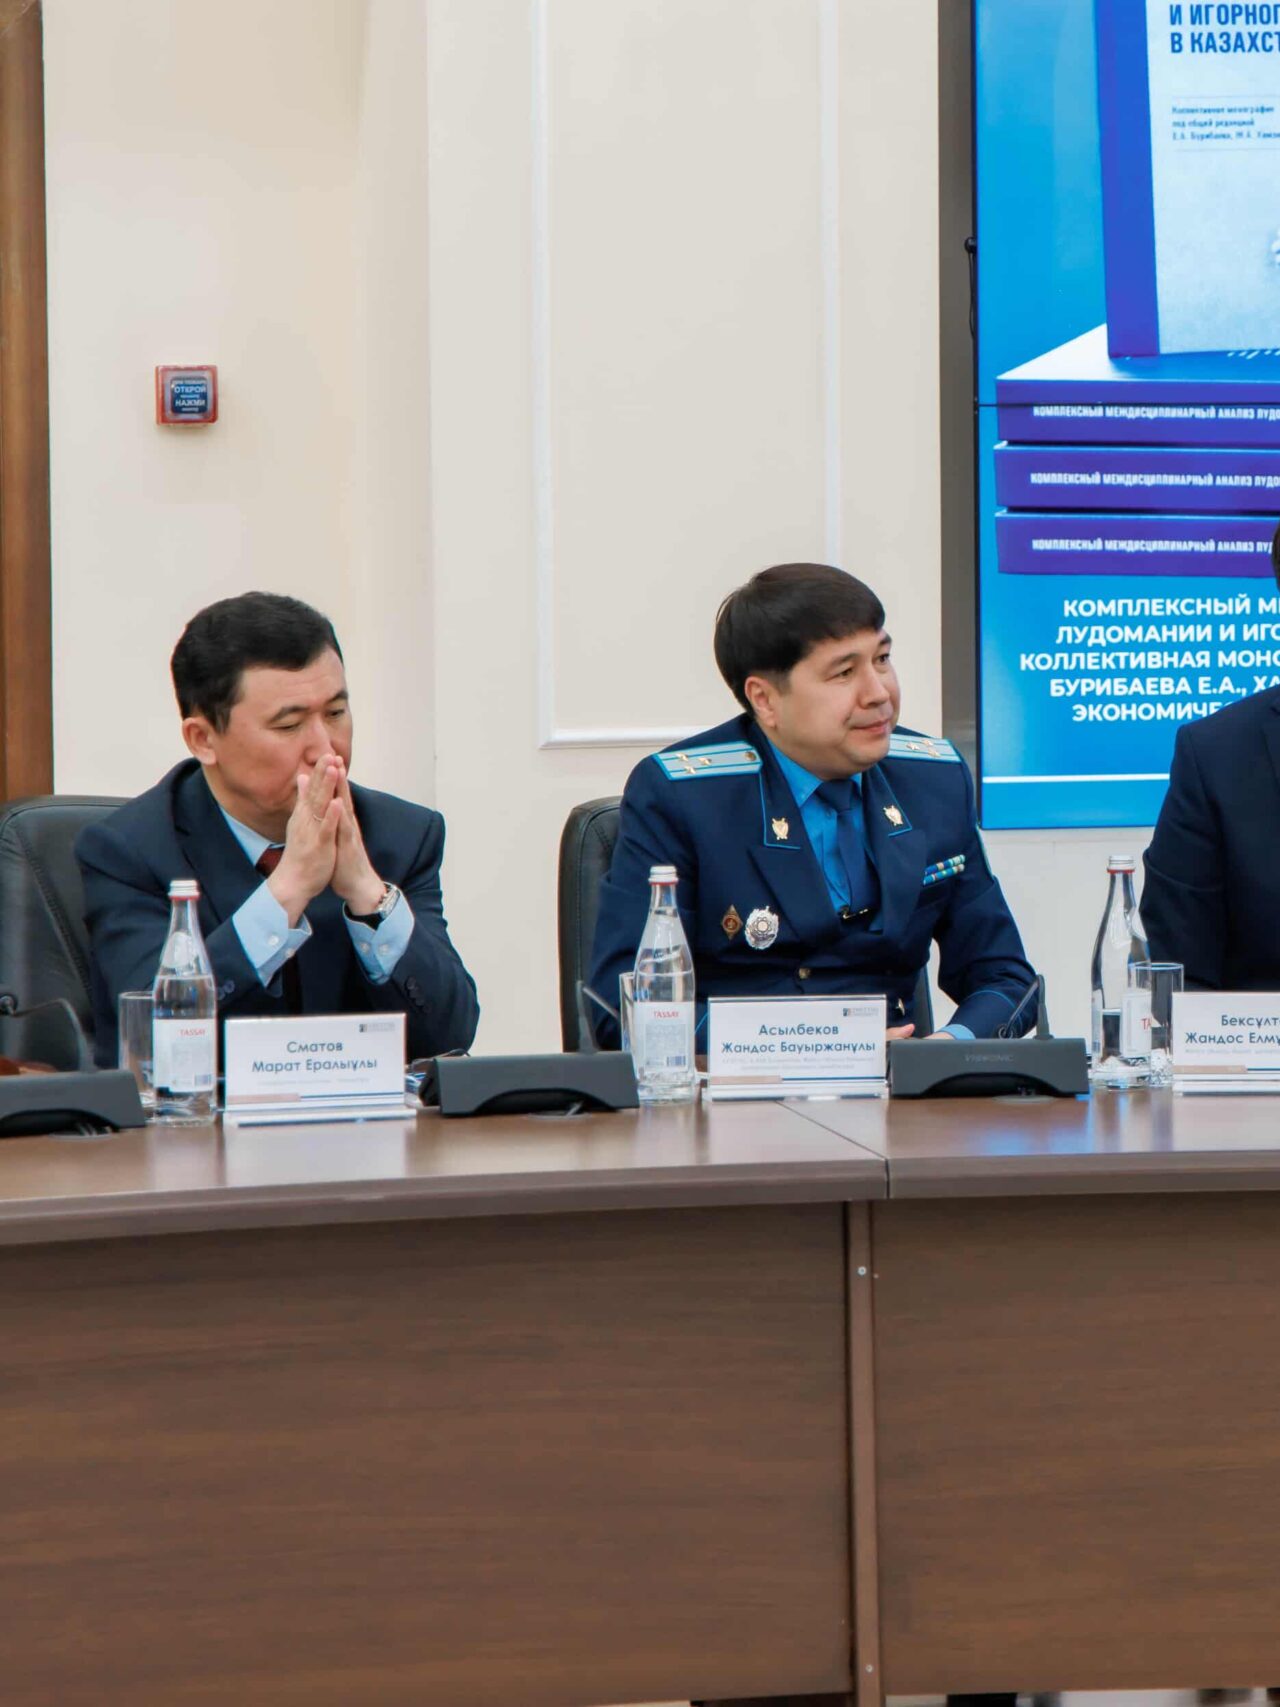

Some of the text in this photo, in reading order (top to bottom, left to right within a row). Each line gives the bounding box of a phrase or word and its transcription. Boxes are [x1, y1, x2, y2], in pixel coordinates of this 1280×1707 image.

[1169, 4, 1183, 25] И
[1170, 32, 1184, 54] В
[1033, 405, 1104, 418] КОМПЛЕКСНЫЙ
[1105, 406, 1216, 420] МЕЖДИСЦИПЛИНАРНЫЙ
[1218, 407, 1255, 419] АНАЛИЗ
[1030, 472, 1101, 485] КОМПЛЕКСНЫЙ
[1103, 473, 1213, 487] МЕЖДИСЦИПЛИНАРНЫЙ
[1215, 474, 1252, 487] АНАЛИЗ
[1032, 538, 1103, 551] КОМПЛЕКСНЫЙ
[1105, 539, 1215, 553] МЕЖДИСЦИПЛИНАРНЫЙ
[1217, 541, 1254, 552] АНАЛИЗ
[1063, 594, 1251, 617] КОМПЛЕКСНЫЙ
[1056, 624, 1213, 647] ЛУДОМАНИИ
[1219, 625, 1236, 642] И
[1020, 650, 1211, 671] КОЛЛЕКТИВНАЯ
[1050, 676, 1192, 697] БУРИБАЕВА
[1198, 675, 1247, 696] Е.А.,
[758, 1023, 839, 1036] Асылбеков
[1185, 1032, 1244, 1044] Жандос
[286, 1040, 343, 1054] Сматов
[722, 1041, 876, 1055] Жандос Бауыржанұлы
[252, 1058, 377, 1074] Марат Ералыұлы
